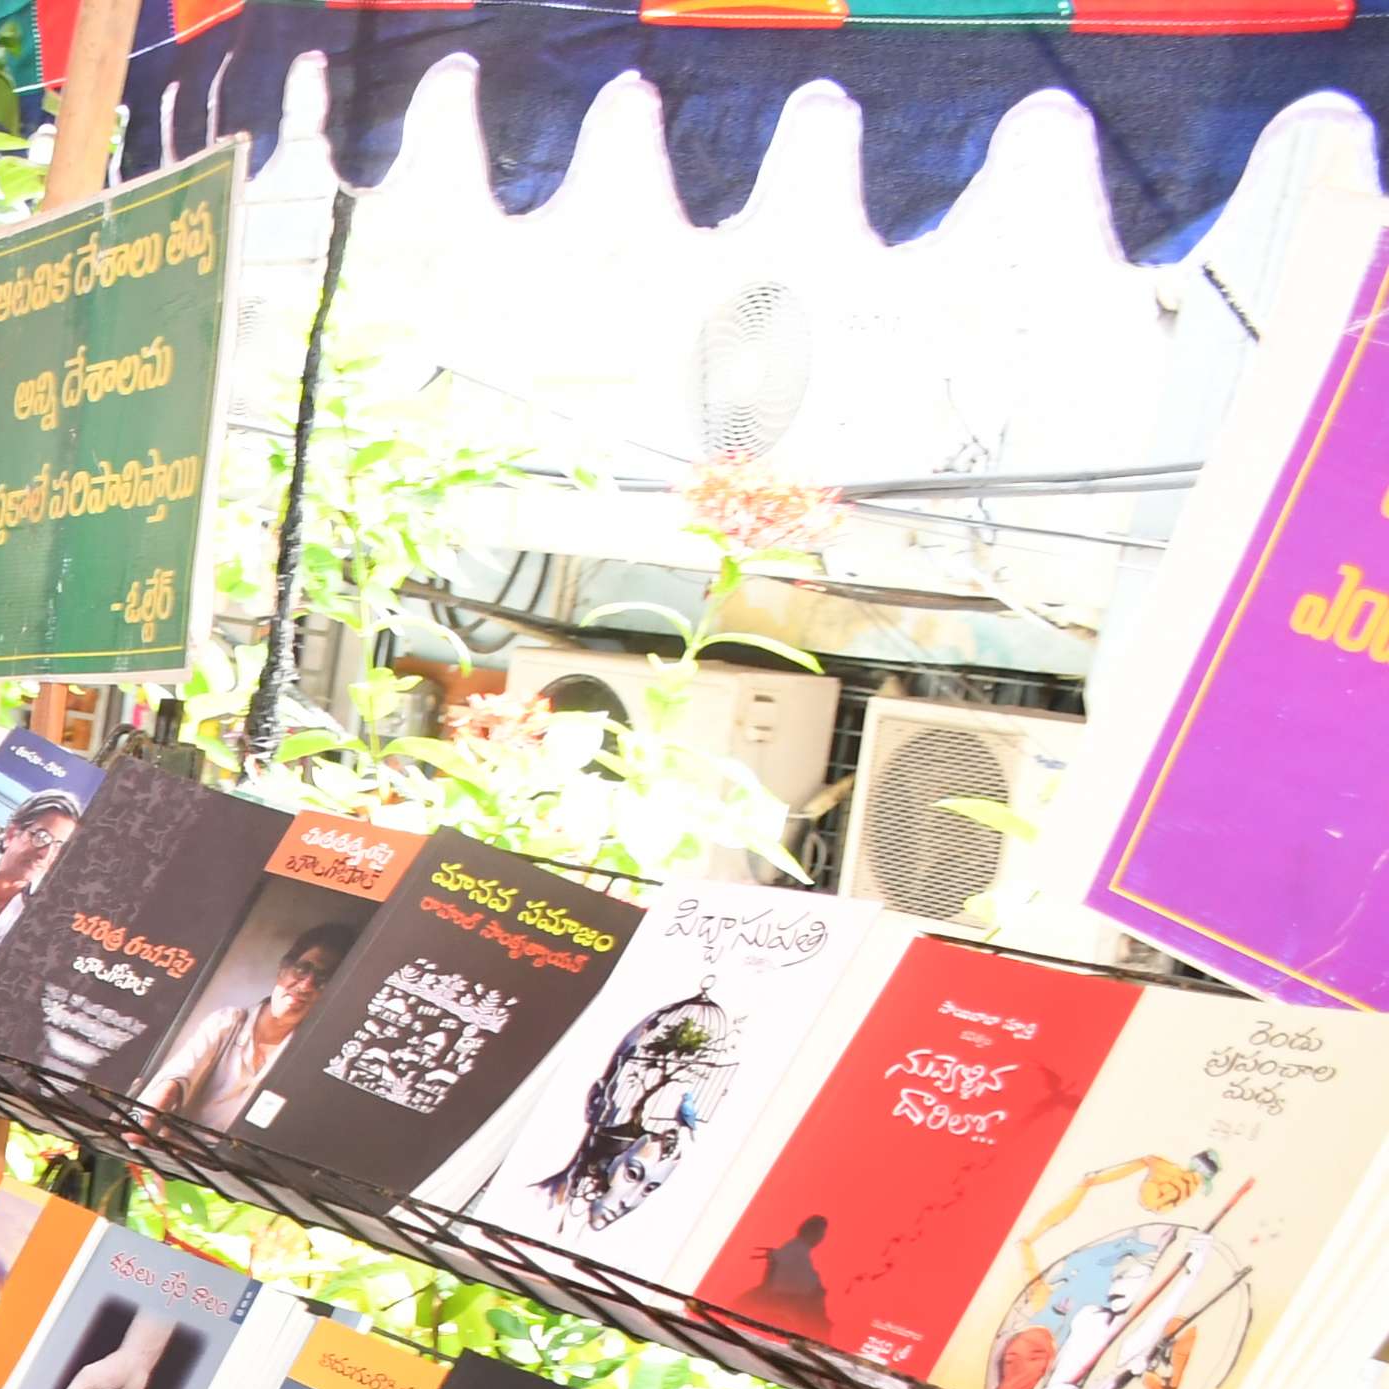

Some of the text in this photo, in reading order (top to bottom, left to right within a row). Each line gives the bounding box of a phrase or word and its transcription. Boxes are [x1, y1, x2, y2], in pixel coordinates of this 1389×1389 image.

[74, 232, 164, 296] దేశాలు
[165, 201, 214, 275] తప్ప
[14, 336, 175, 431] అన్ని దేశాలను
[49, 448, 199, 523] పరిపాలిస్తాయి
[71, 912, 128, 952] చరిత్ర
[430, 861, 615, 953] మానవ సమాజం
[1203, 1046, 1336, 1082] ప్రపంచాల
[1249, 1021, 1323, 1052] రెండు
[1222, 1077, 1285, 1116] మధ్య
[159, 1263, 193, 1307] లేని
[191, 1286, 229, 1318] కాలం
